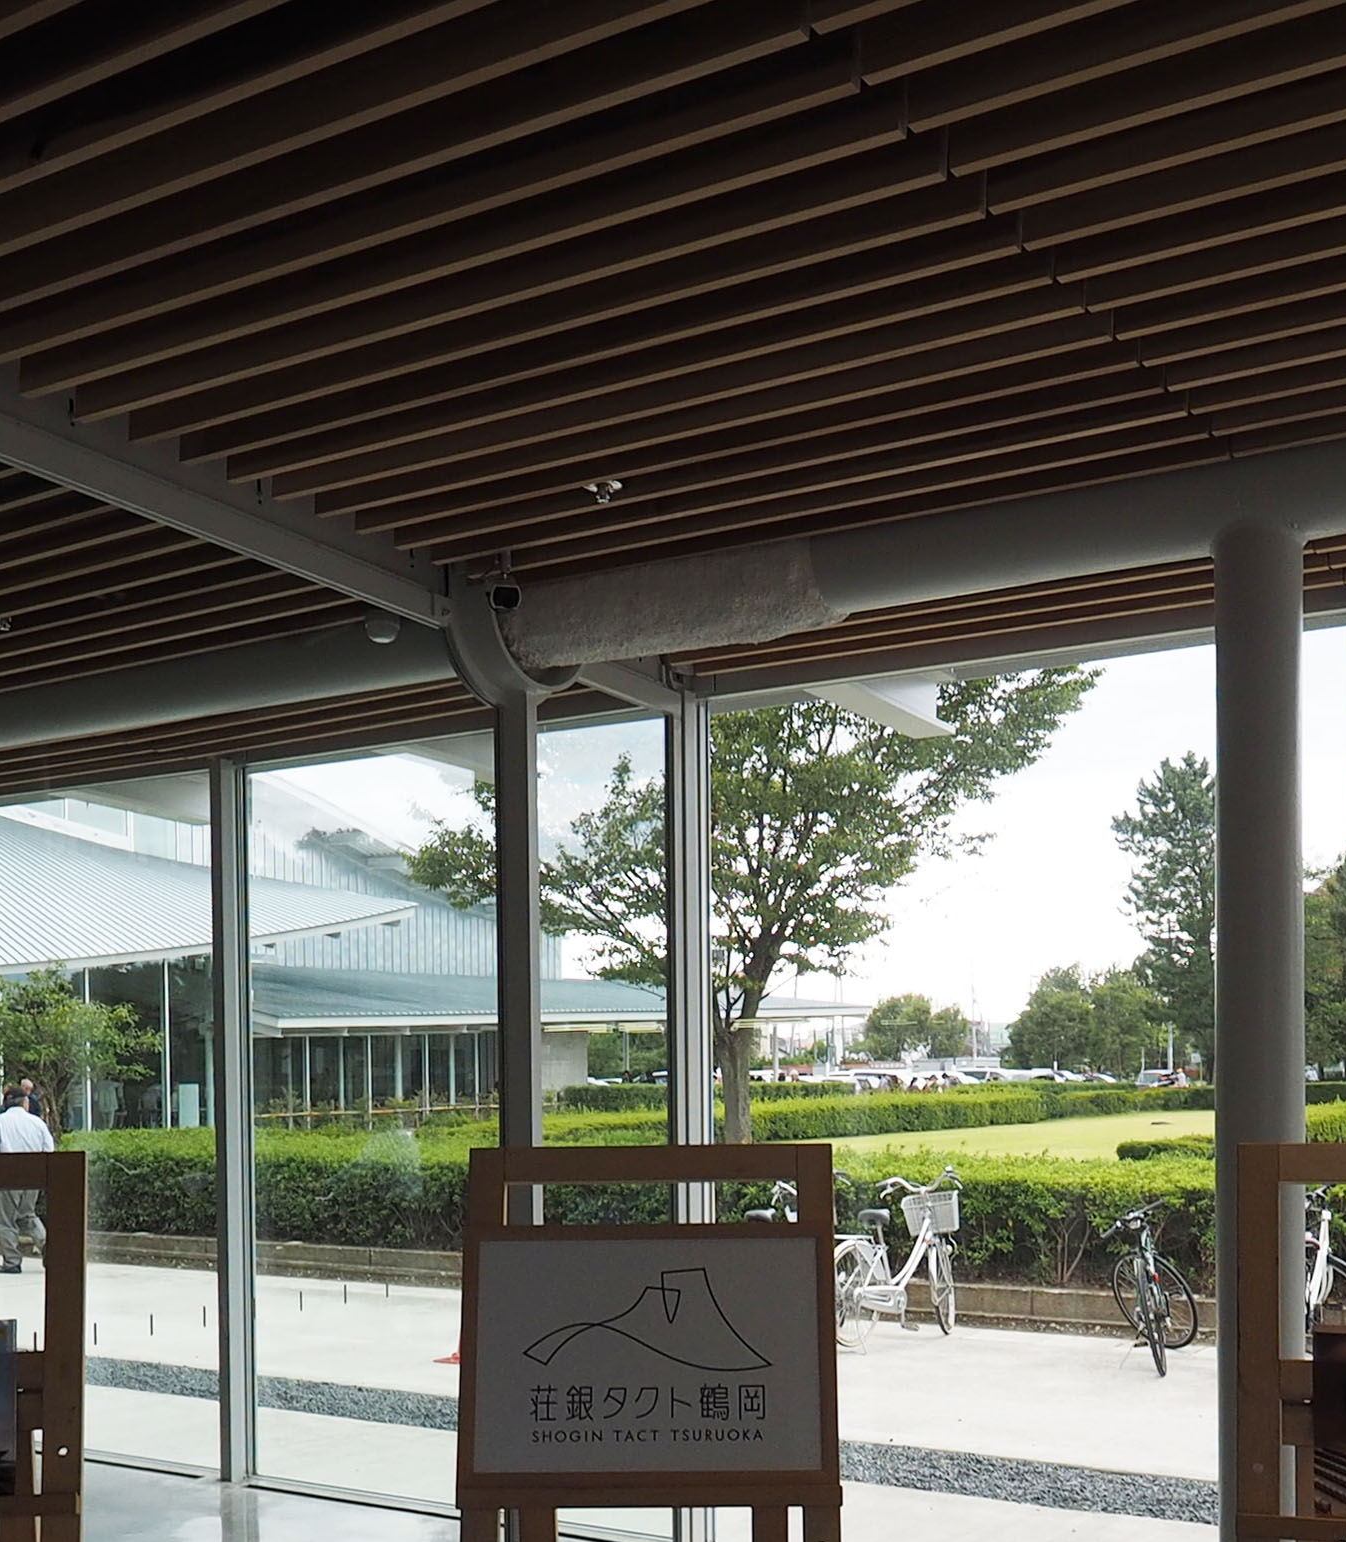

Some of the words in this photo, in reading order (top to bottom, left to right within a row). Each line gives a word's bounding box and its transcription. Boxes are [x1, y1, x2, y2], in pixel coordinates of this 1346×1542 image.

[529, 1384, 767, 1422] 荘銀タクト鶴岡
[531, 1429, 604, 1443] SHOGIN
[613, 1429, 660, 1443] TACT
[671, 1428, 764, 1442] TSURUOKA
